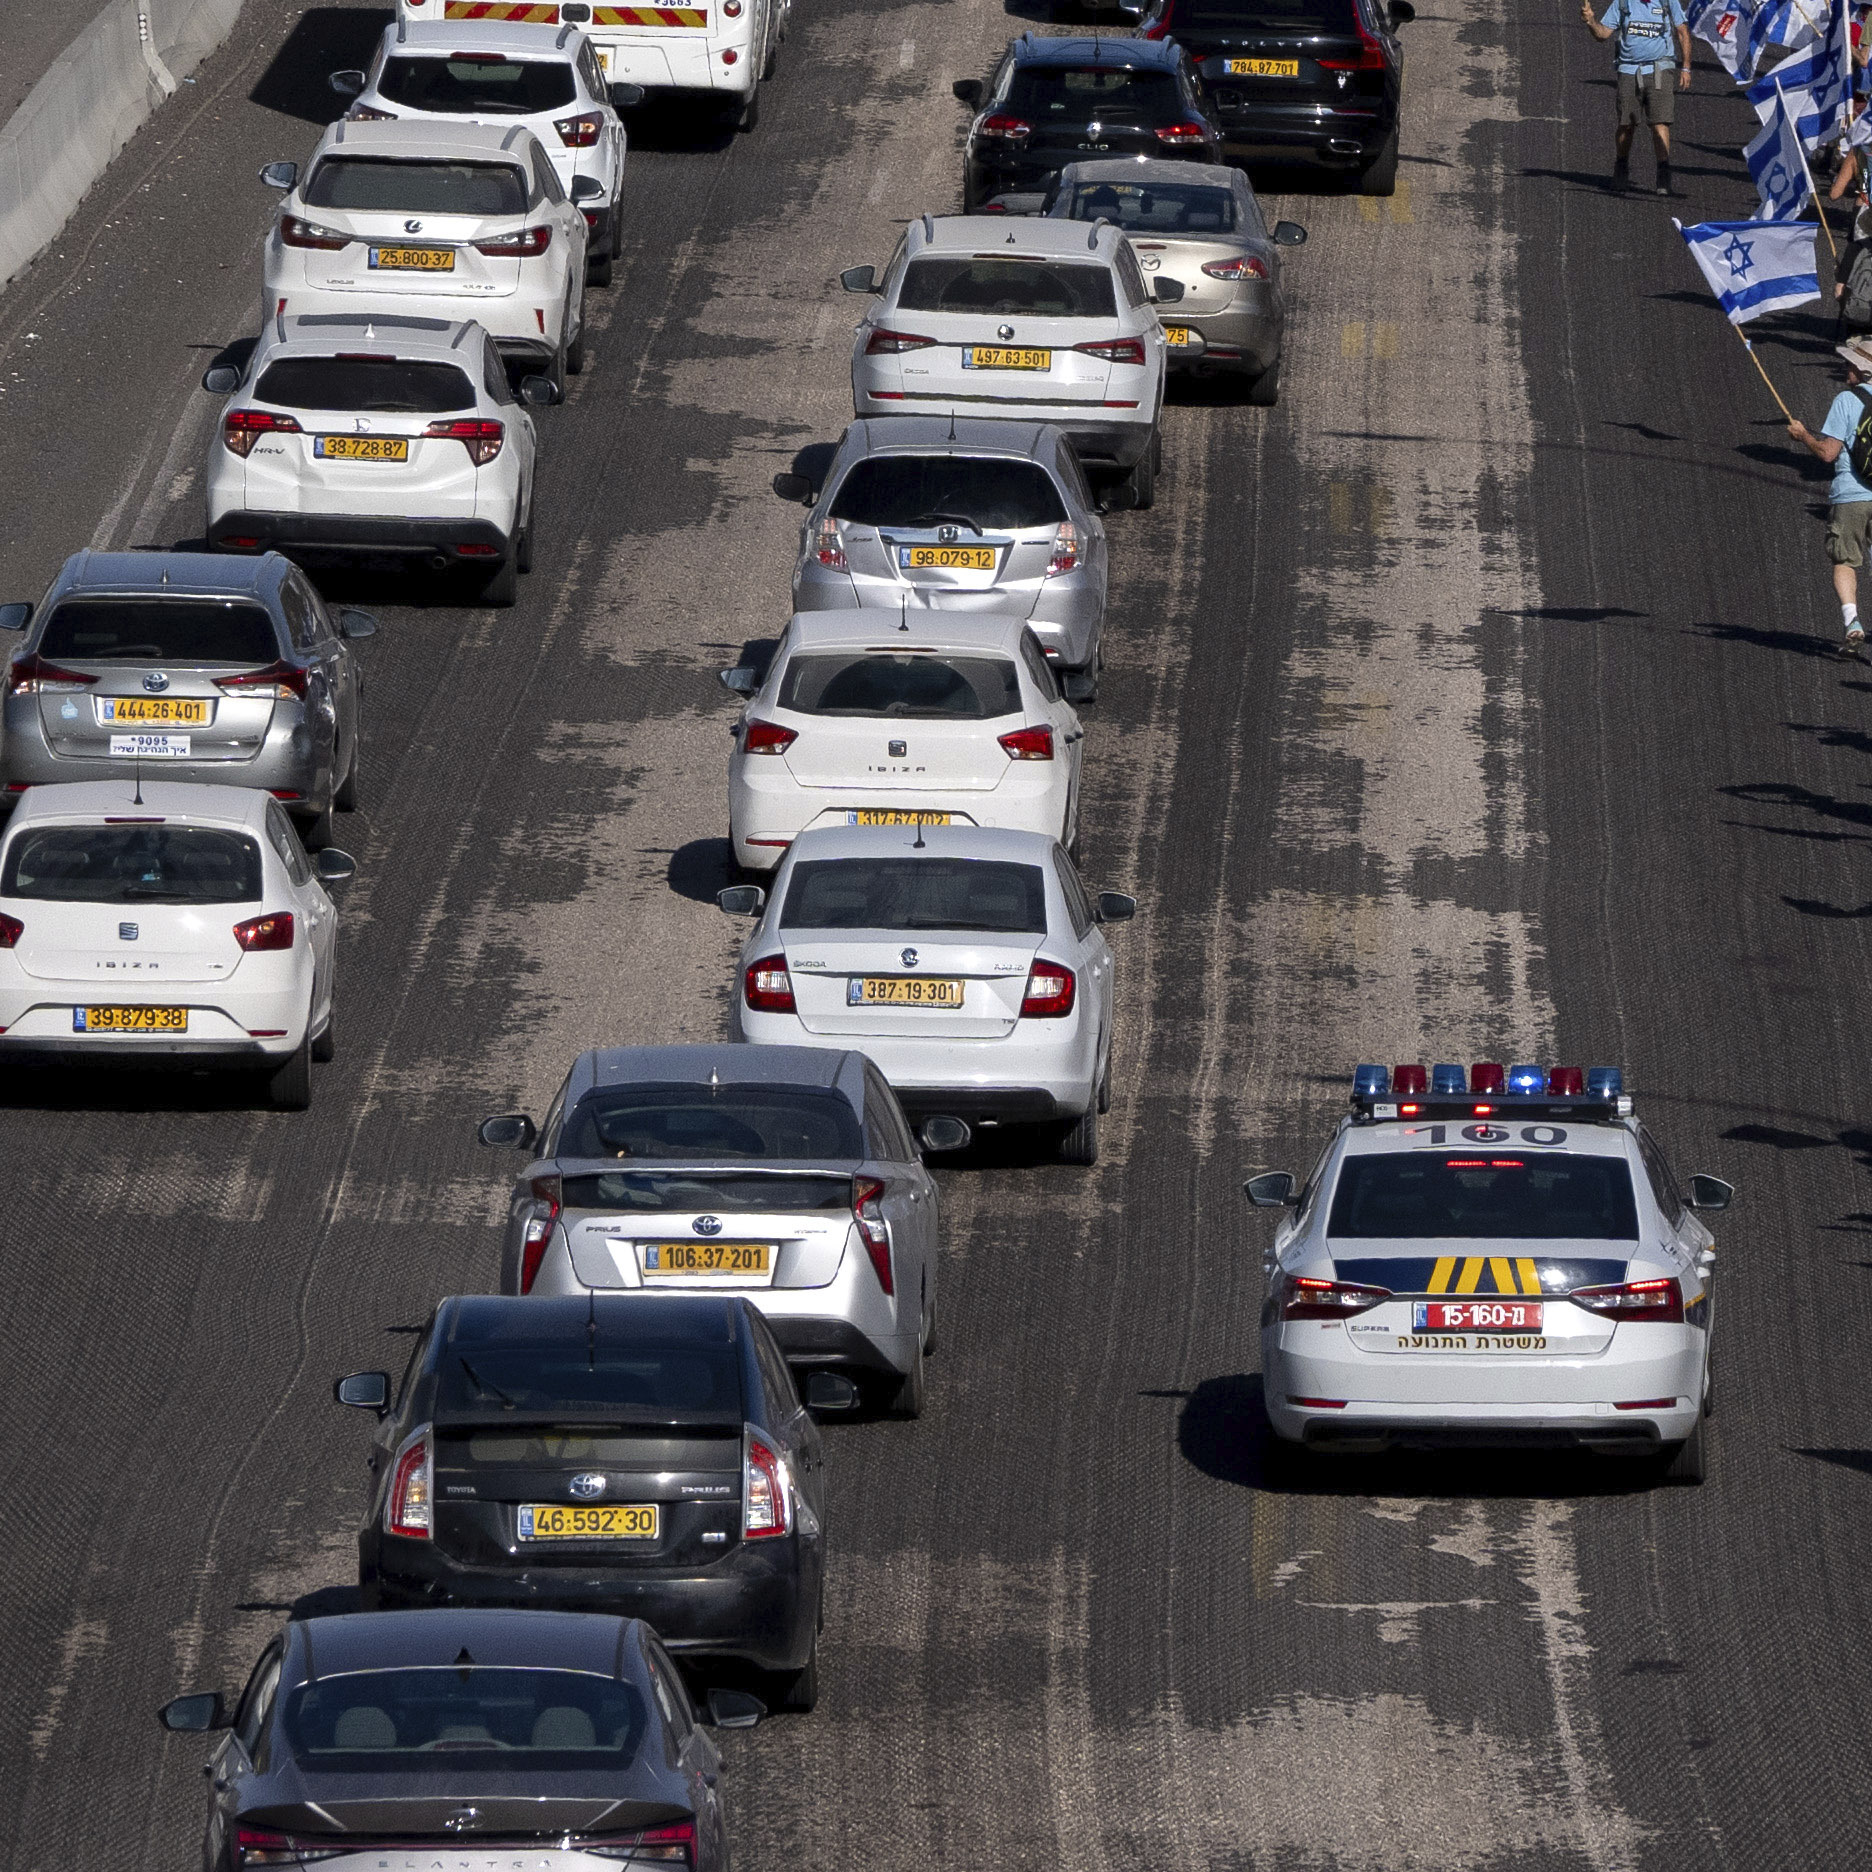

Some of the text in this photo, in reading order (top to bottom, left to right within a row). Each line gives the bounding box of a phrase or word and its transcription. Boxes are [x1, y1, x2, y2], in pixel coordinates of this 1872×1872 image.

[173, 746, 187, 757] איך
[96, 961, 159, 970] IBIZA
[1413, 1124, 1568, 1148] 160
[1397, 1334, 1547, 1350] משטרת התנועה
